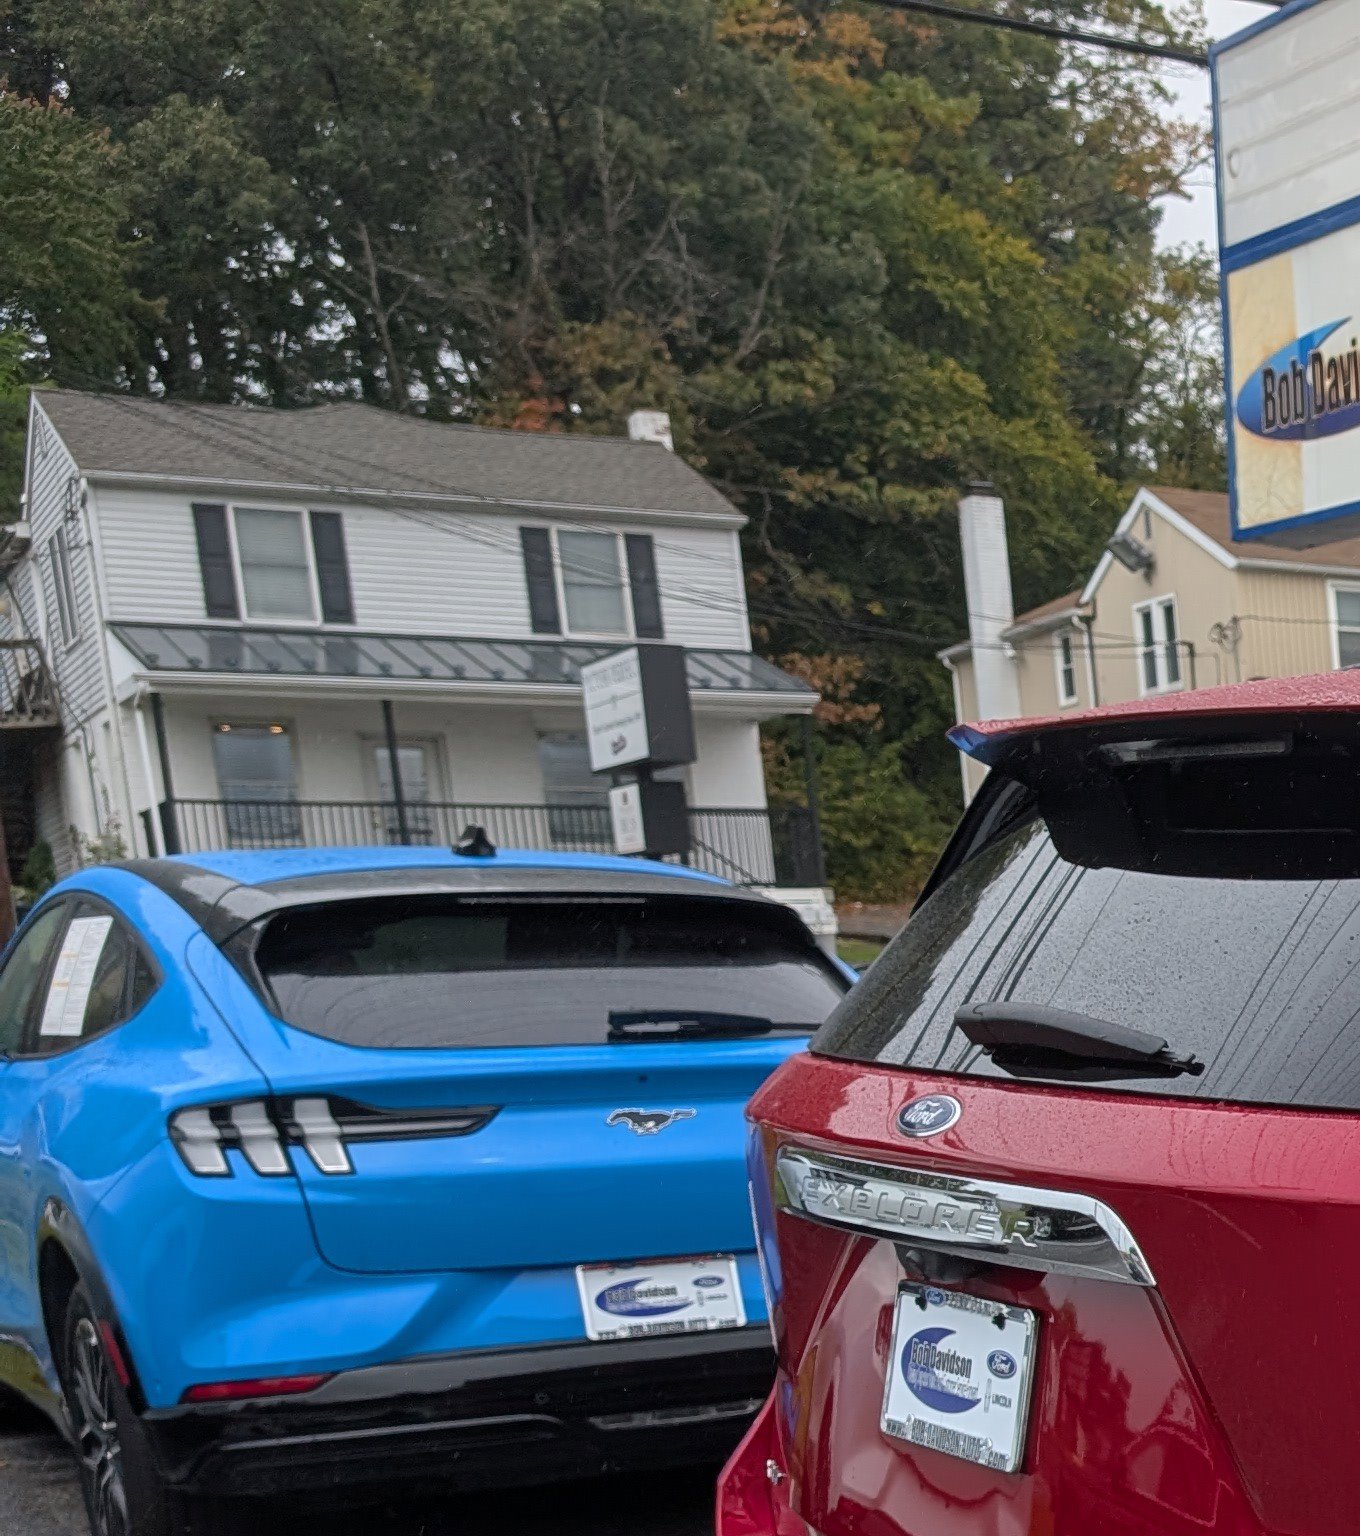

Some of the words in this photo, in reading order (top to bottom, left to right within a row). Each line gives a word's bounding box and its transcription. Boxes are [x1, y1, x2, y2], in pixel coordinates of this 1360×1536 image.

[1262, 358, 1306, 433] Bob
[802, 1175, 1038, 1248] EXPLORER
[911, 1338, 930, 1367] Bob
[930, 1343, 973, 1379] Davidson
[990, 1352, 1012, 1374] Ford
